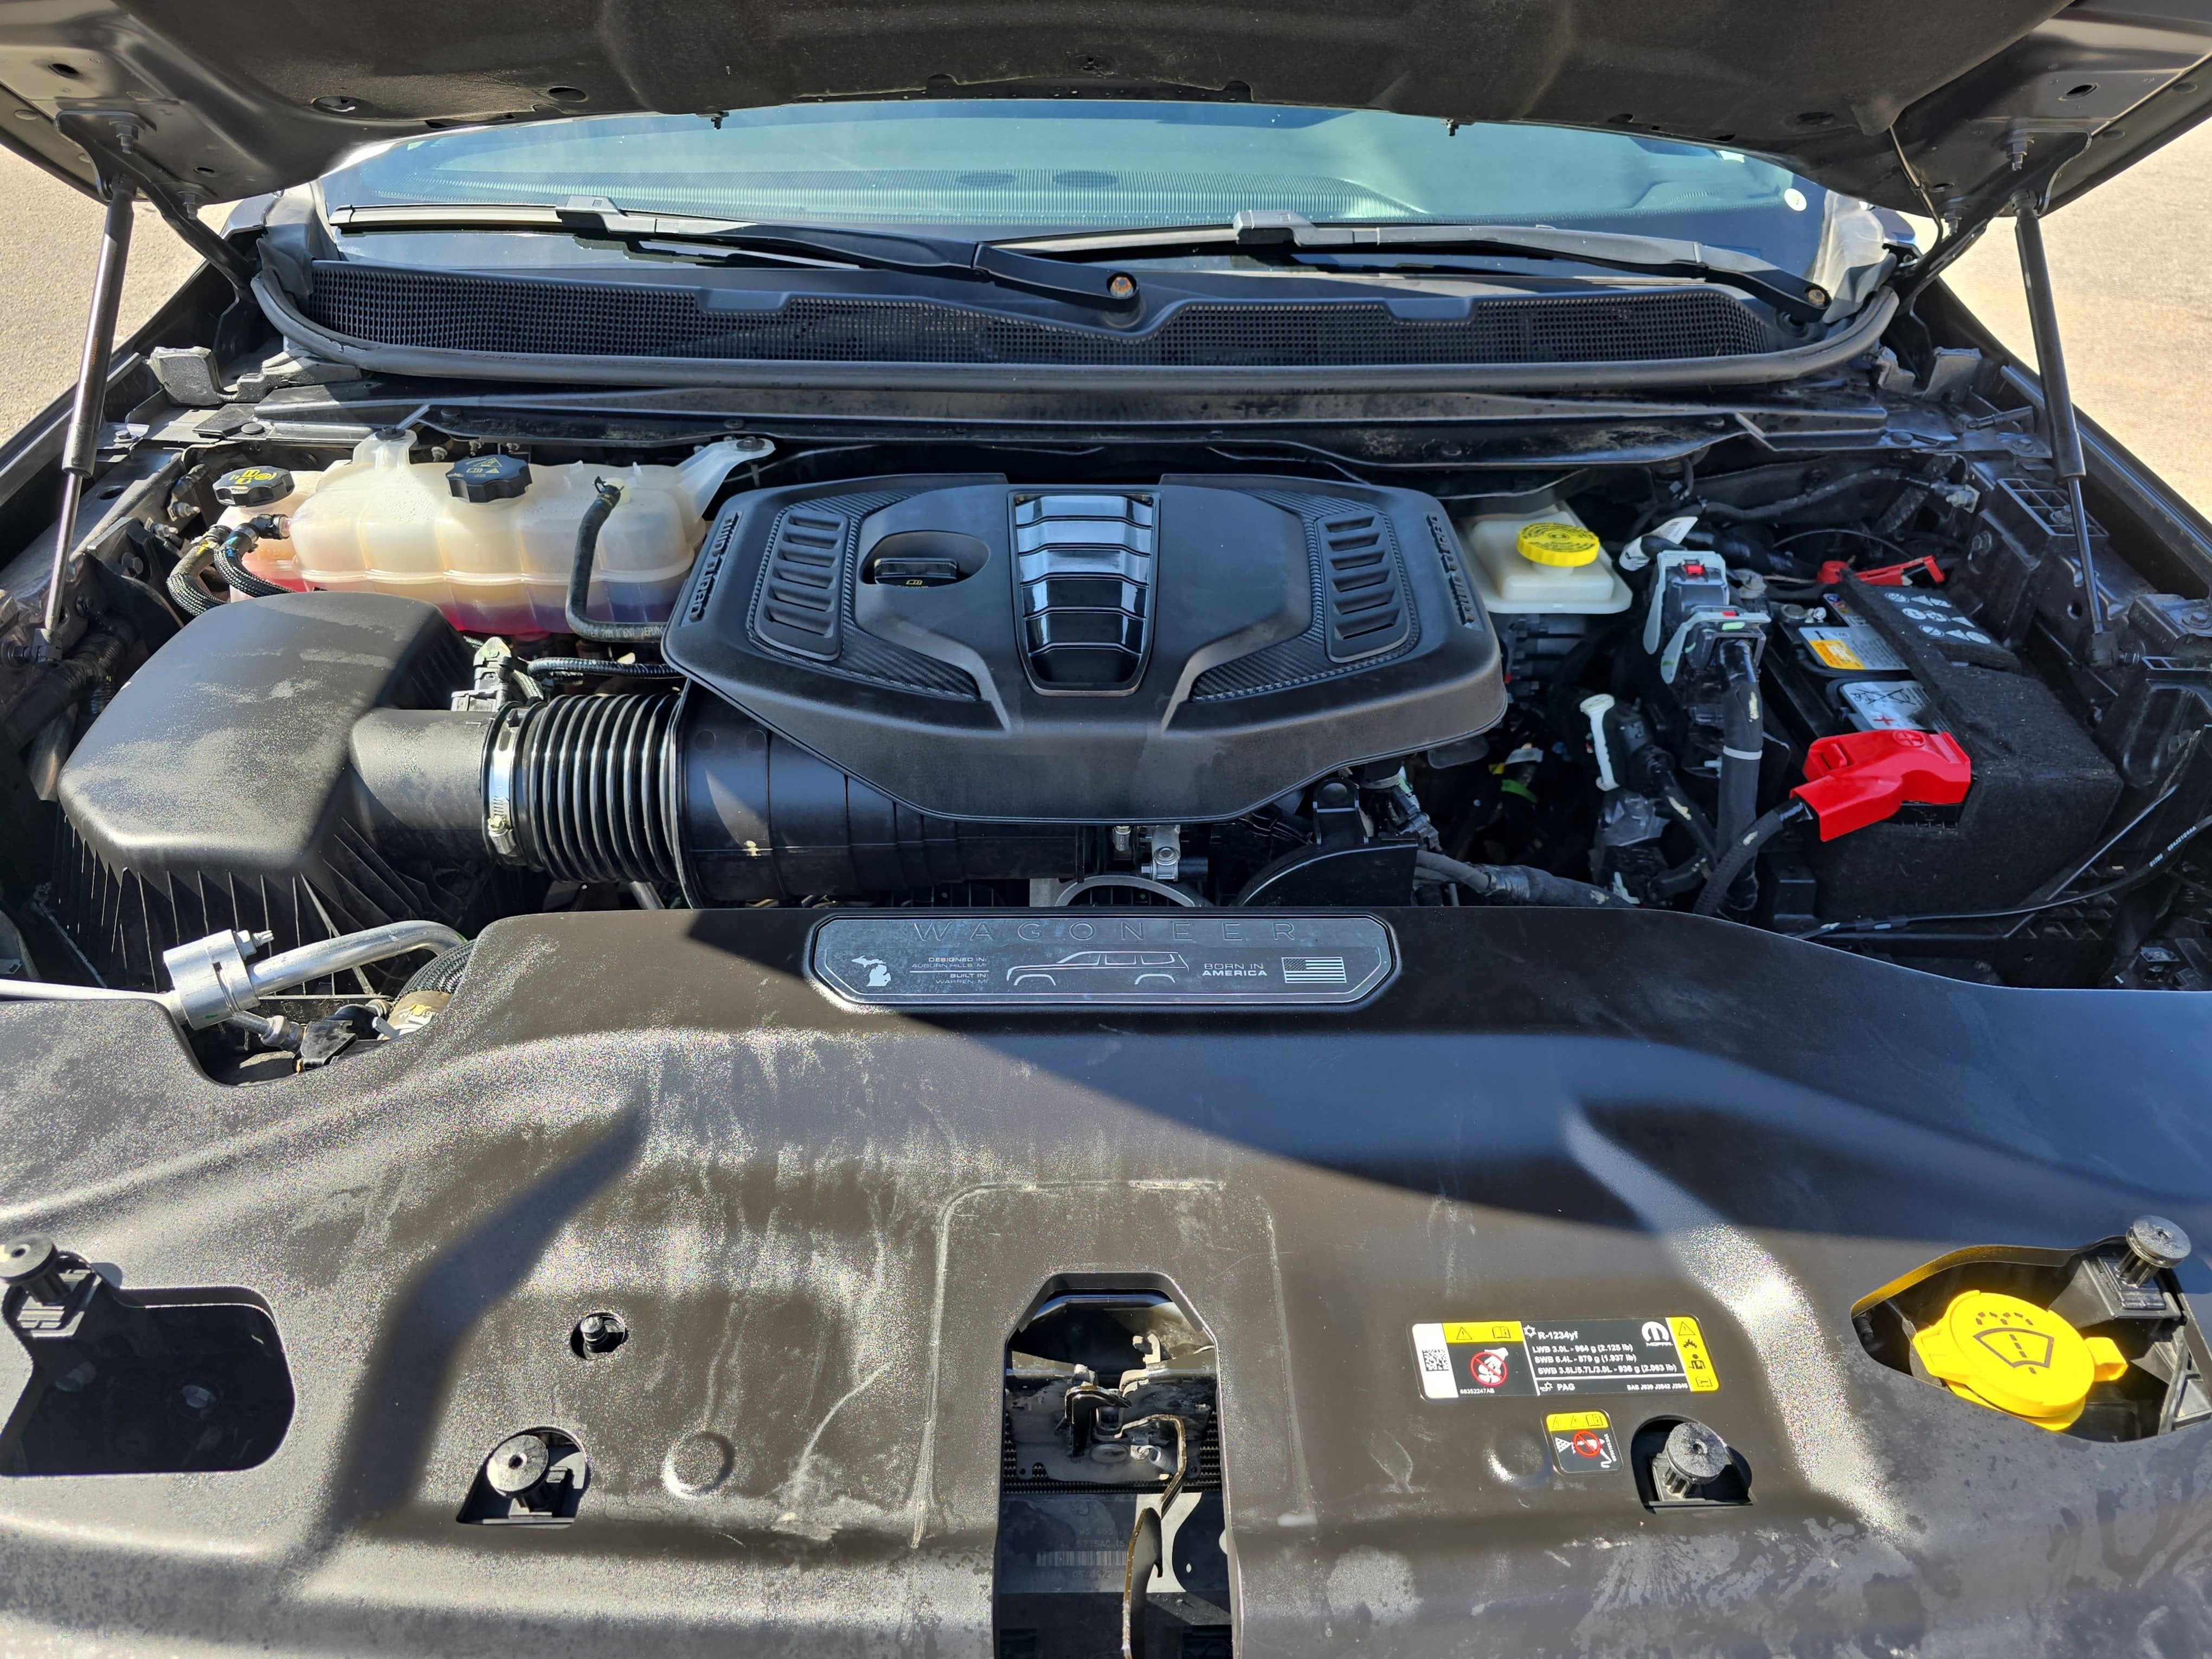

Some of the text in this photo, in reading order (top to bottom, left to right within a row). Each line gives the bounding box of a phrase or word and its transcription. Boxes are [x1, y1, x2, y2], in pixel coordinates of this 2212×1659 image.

[914, 922, 1295, 941] WAGONEER
[1538, 1330, 1578, 1341] R-1234yf
[1552, 1345, 1570, 1353] 3.0L
[1597, 1344, 1621, 1353] (2.125
[1622, 1343, 1634, 1353] lb)
[1534, 1355, 1554, 1364] SWB
[1625, 1354, 1637, 1362] lb)
[1538, 1366, 1557, 1374] SWB
[1634, 1366, 1641, 1374] g
[1665, 1364, 1677, 1373] lb)
[1557, 1382, 1576, 1391] PAG
